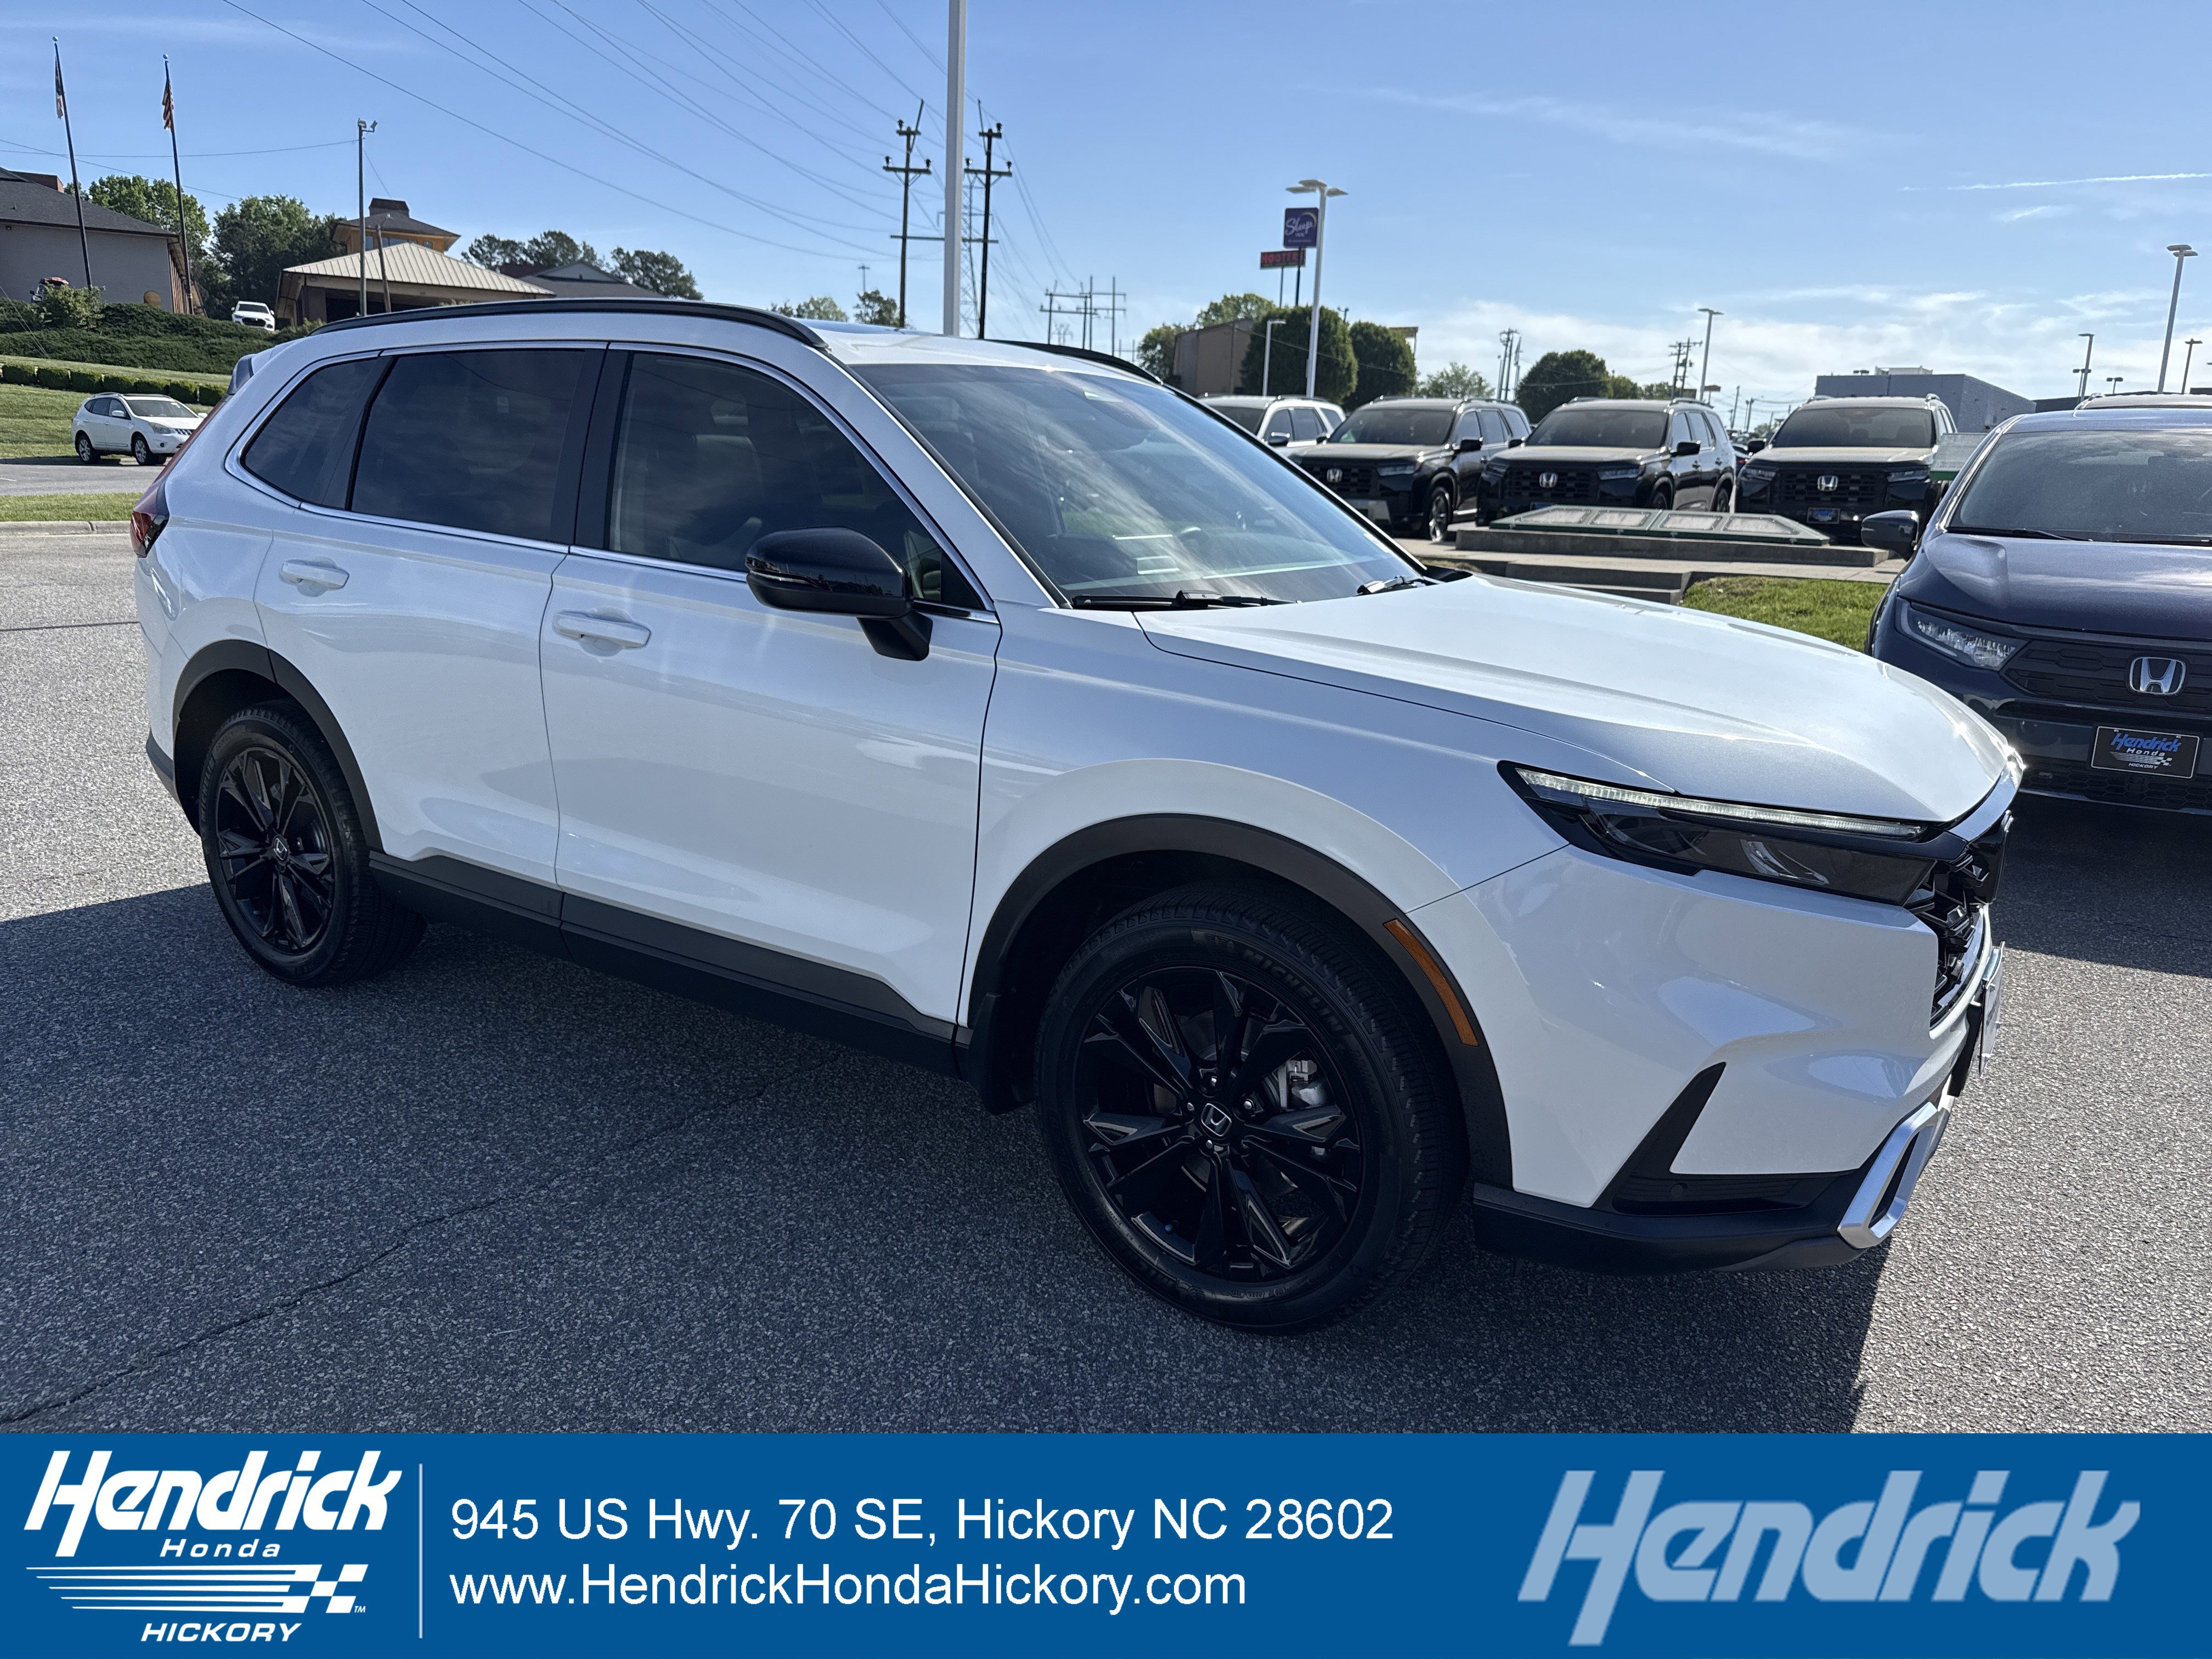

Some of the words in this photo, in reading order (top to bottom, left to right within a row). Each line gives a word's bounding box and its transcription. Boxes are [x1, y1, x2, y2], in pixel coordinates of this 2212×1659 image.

[2111, 732, 2182, 752] Hendrick
[2126, 748, 2165, 756] Honda
[1242, 948, 1344, 1031] MICHELIN
